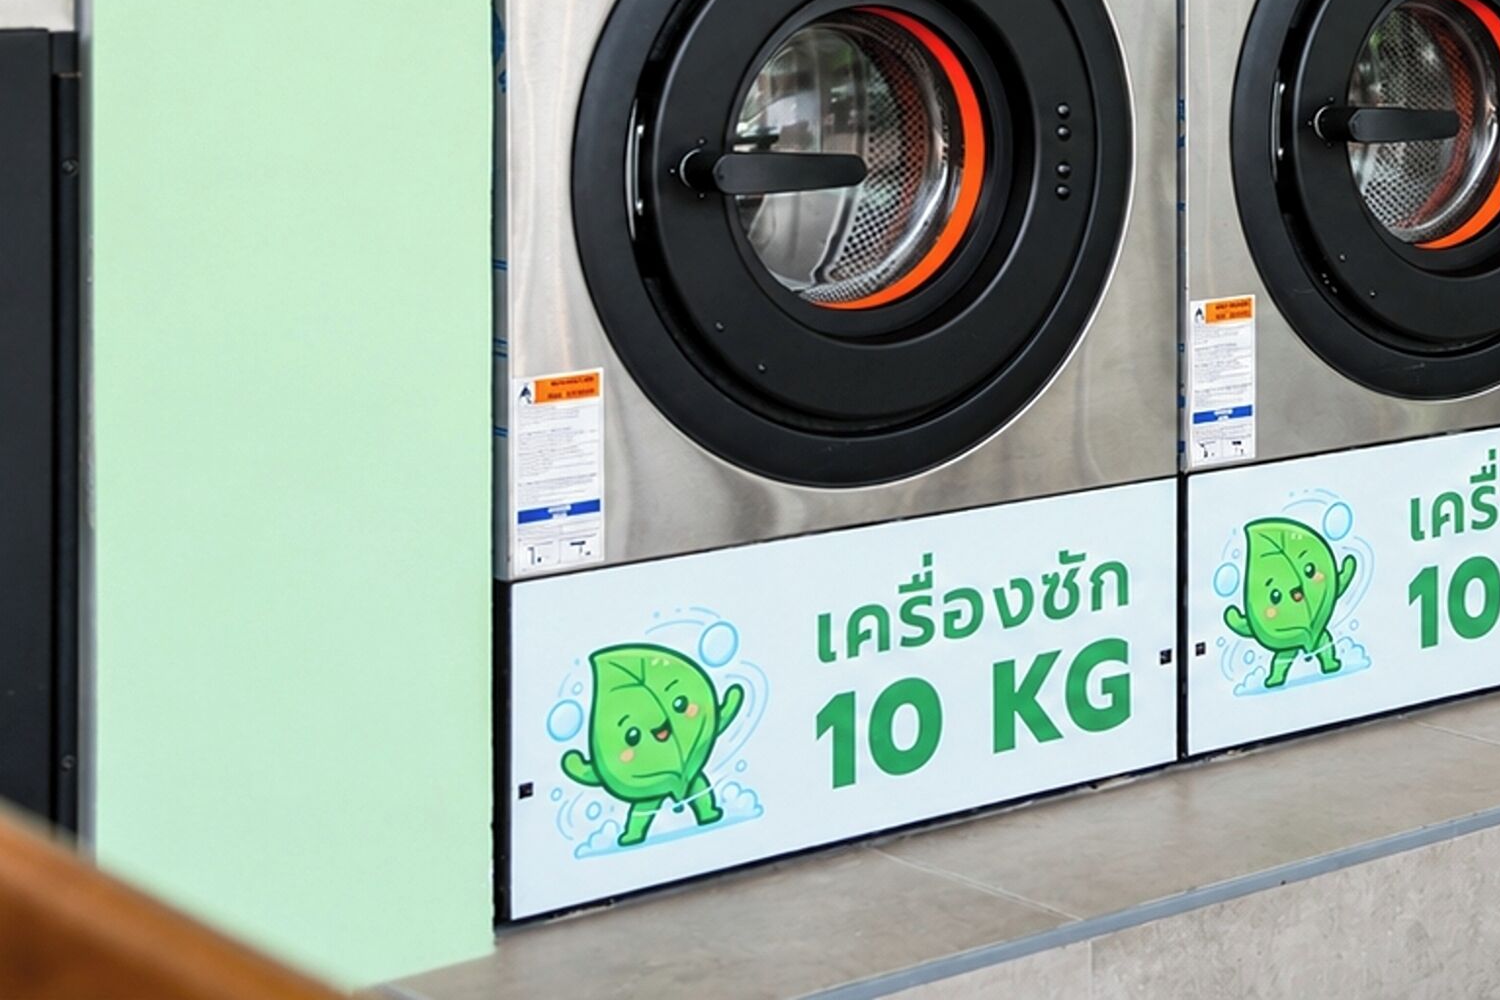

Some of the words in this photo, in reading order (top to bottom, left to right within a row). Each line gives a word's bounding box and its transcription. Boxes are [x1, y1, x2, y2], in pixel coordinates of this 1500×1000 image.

[817, 550, 1131, 664] เครื่องซัก
[815, 676, 944, 790] 10
[991, 637, 1132, 754] KG
